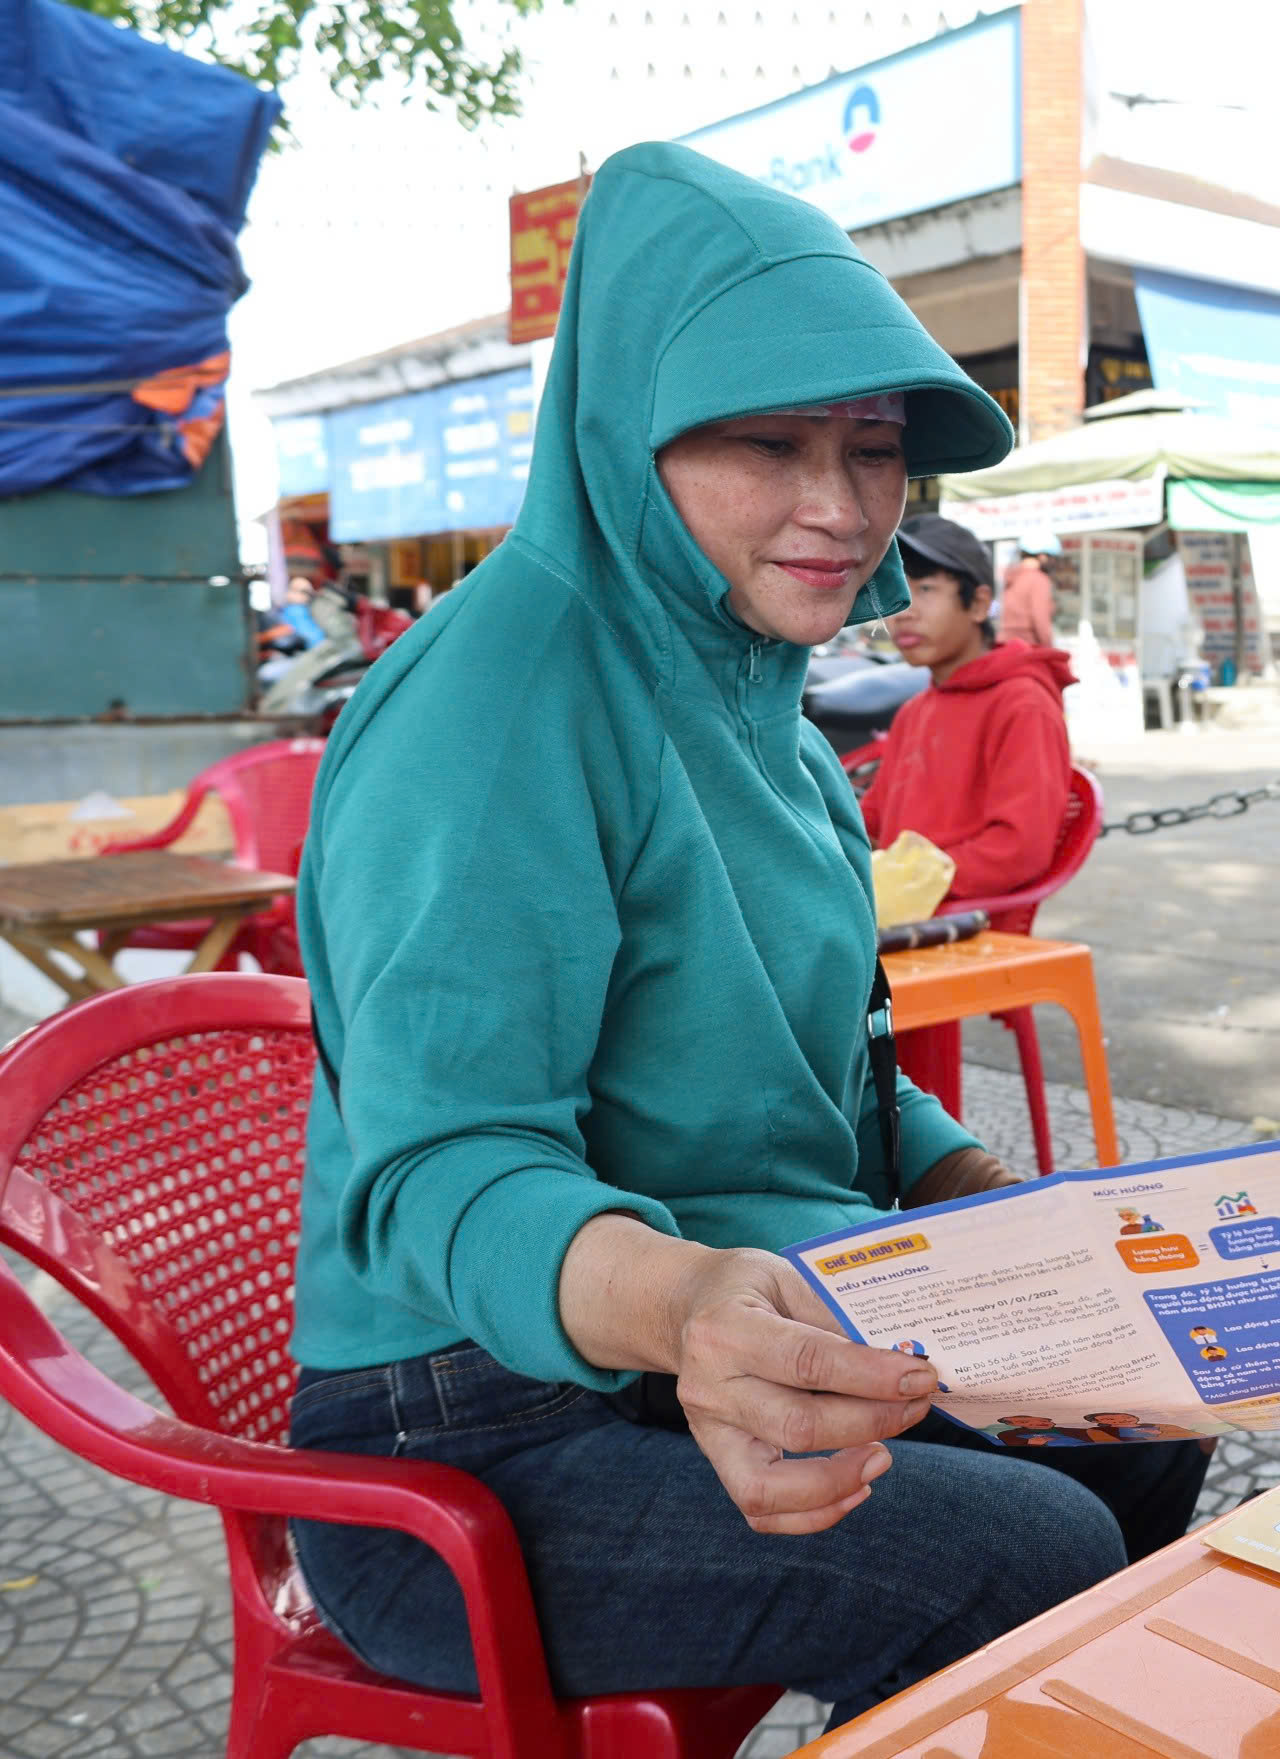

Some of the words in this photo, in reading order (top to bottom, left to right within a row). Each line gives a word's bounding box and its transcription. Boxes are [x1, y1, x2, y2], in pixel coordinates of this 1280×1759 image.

[1094, 1189, 1117, 1197] MỨC
[1120, 1182, 1163, 1193] HƯỞNG
[824, 1254, 848, 1271] CHẾ
[850, 1251, 866, 1265] ĐỘ
[869, 1244, 893, 1259] HƯU
[894, 1238, 914, 1252] TRÍ
[836, 1279, 860, 1293] ĐIỀU
[862, 1273, 886, 1287] KIỆN
[888, 1263, 929, 1279] HƯỞNG
[1149, 1290, 1177, 1304] Trong
[1200, 1288, 1209, 1297] tỷ
[1213, 1285, 1223, 1294] lệ
[1227, 1280, 1258, 1292] hưởng
[1154, 1299, 1181, 1311] người
[1182, 1297, 1198, 1306] lao
[1200, 1293, 1224, 1305] động
[1225, 1289, 1250, 1300] được
[1251, 1285, 1269, 1294] tính
[1159, 1308, 1179, 1317] năm
[1181, 1304, 1206, 1316] đóng
[1207, 1299, 1236, 1310] BHXH
[1238, 1295, 1256, 1305] như
[1258, 1292, 1278, 1301] sau:
[869, 1327, 883, 1337] Đủ
[884, 1322, 901, 1333] tuổi
[904, 1318, 924, 1330] nghỉ
[926, 1313, 945, 1324] hưu:
[947, 1309, 959, 1318] Kể
[962, 1307, 971, 1315] từ
[972, 1303, 995, 1314] ngày
[932, 1324, 957, 1335] Nam:
[961, 1320, 974, 1329] Đủ
[977, 1316, 989, 1325] 60
[992, 1311, 1009, 1322] tuổi
[1011, 1309, 1023, 1317] 09
[1058, 1298, 1074, 1308] Sau
[1096, 1287, 1113, 1299] mỗi
[1224, 1324, 1242, 1333] Lao
[1244, 1319, 1269, 1331] động
[1236, 1345, 1254, 1354] Lao
[1255, 1340, 1280, 1351] động
